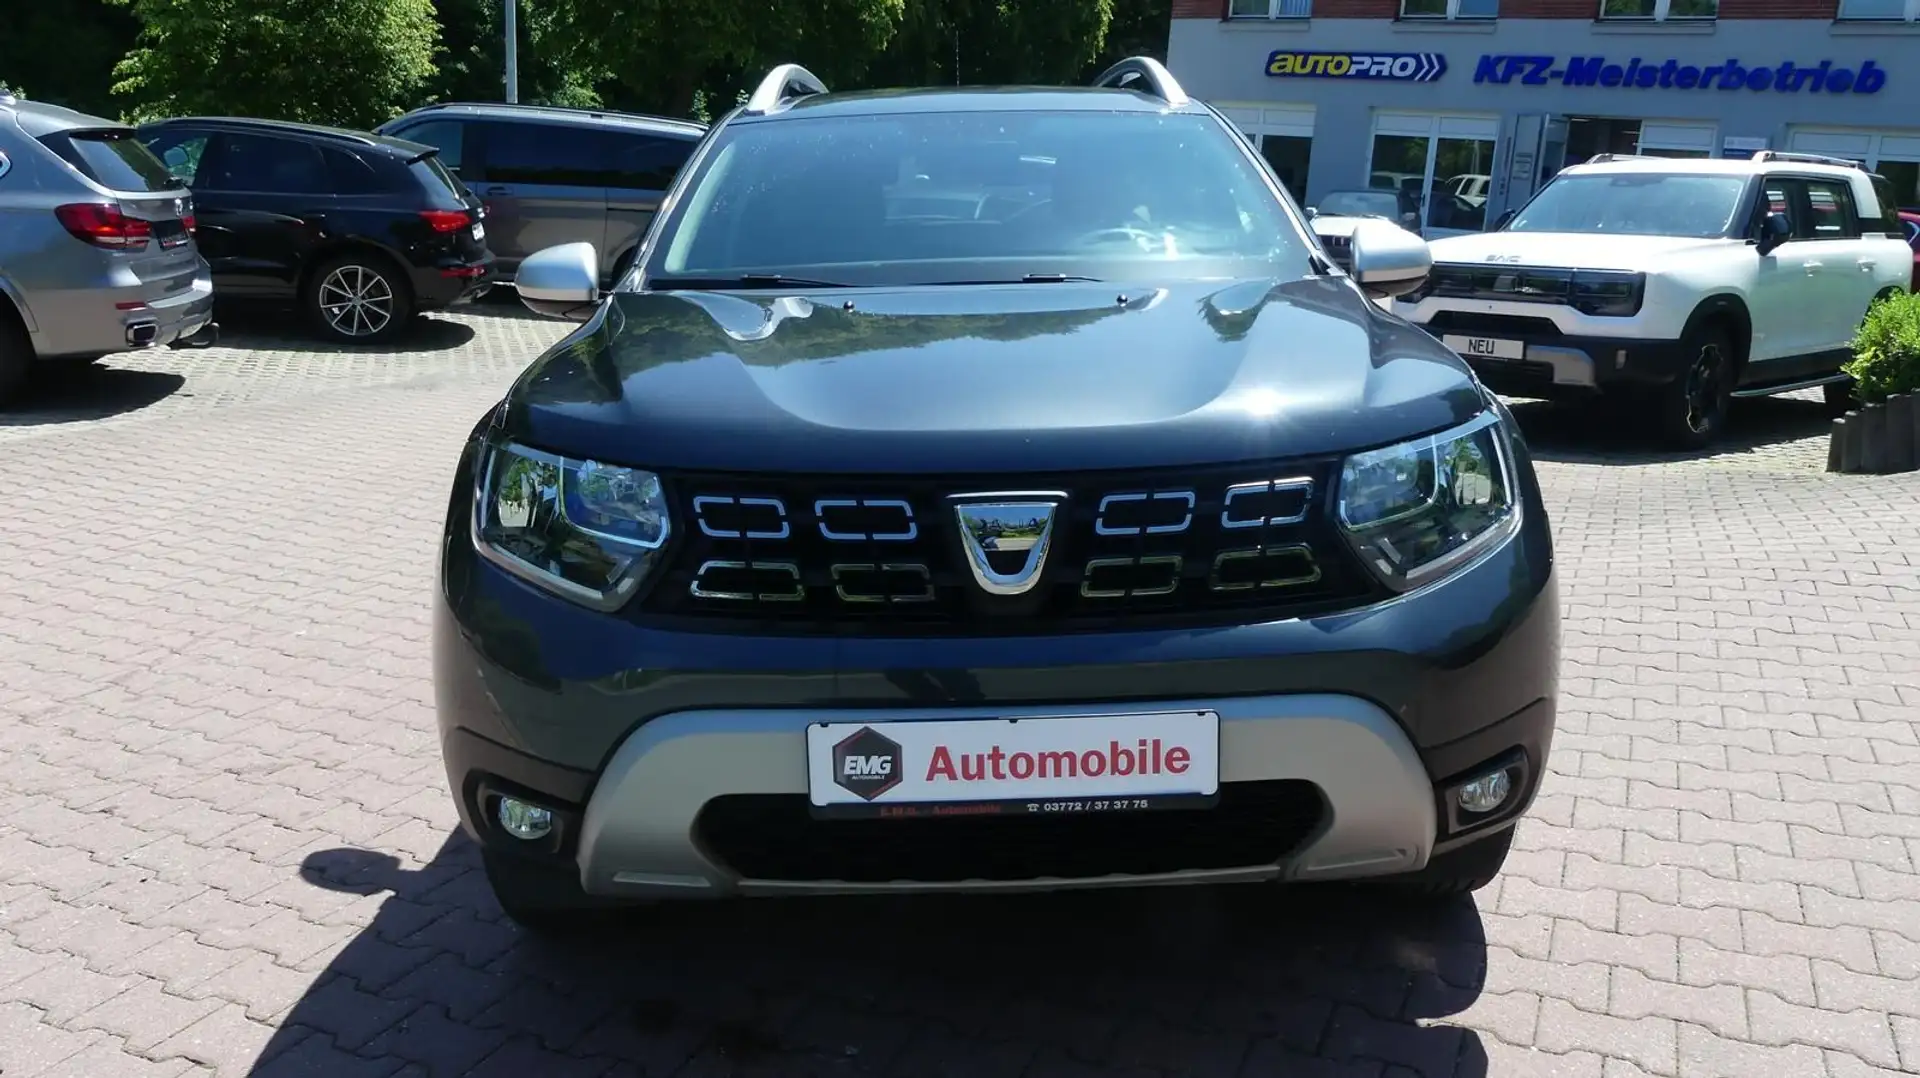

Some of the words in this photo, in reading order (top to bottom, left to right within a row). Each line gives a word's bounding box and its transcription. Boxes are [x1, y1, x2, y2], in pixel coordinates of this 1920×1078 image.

[1473, 54, 1886, 95] KFZ-Meisterbetrieb
[1468, 339, 1495, 355] NEU
[844, 755, 892, 775] EMG
[926, 738, 1191, 782] Automobile
[1044, 802, 1082, 812] 03772
[1085, 801, 1091, 811] /
[1094, 801, 1109, 810] 37
[1113, 800, 1129, 810] 37
[1133, 799, 1149, 809] 75
